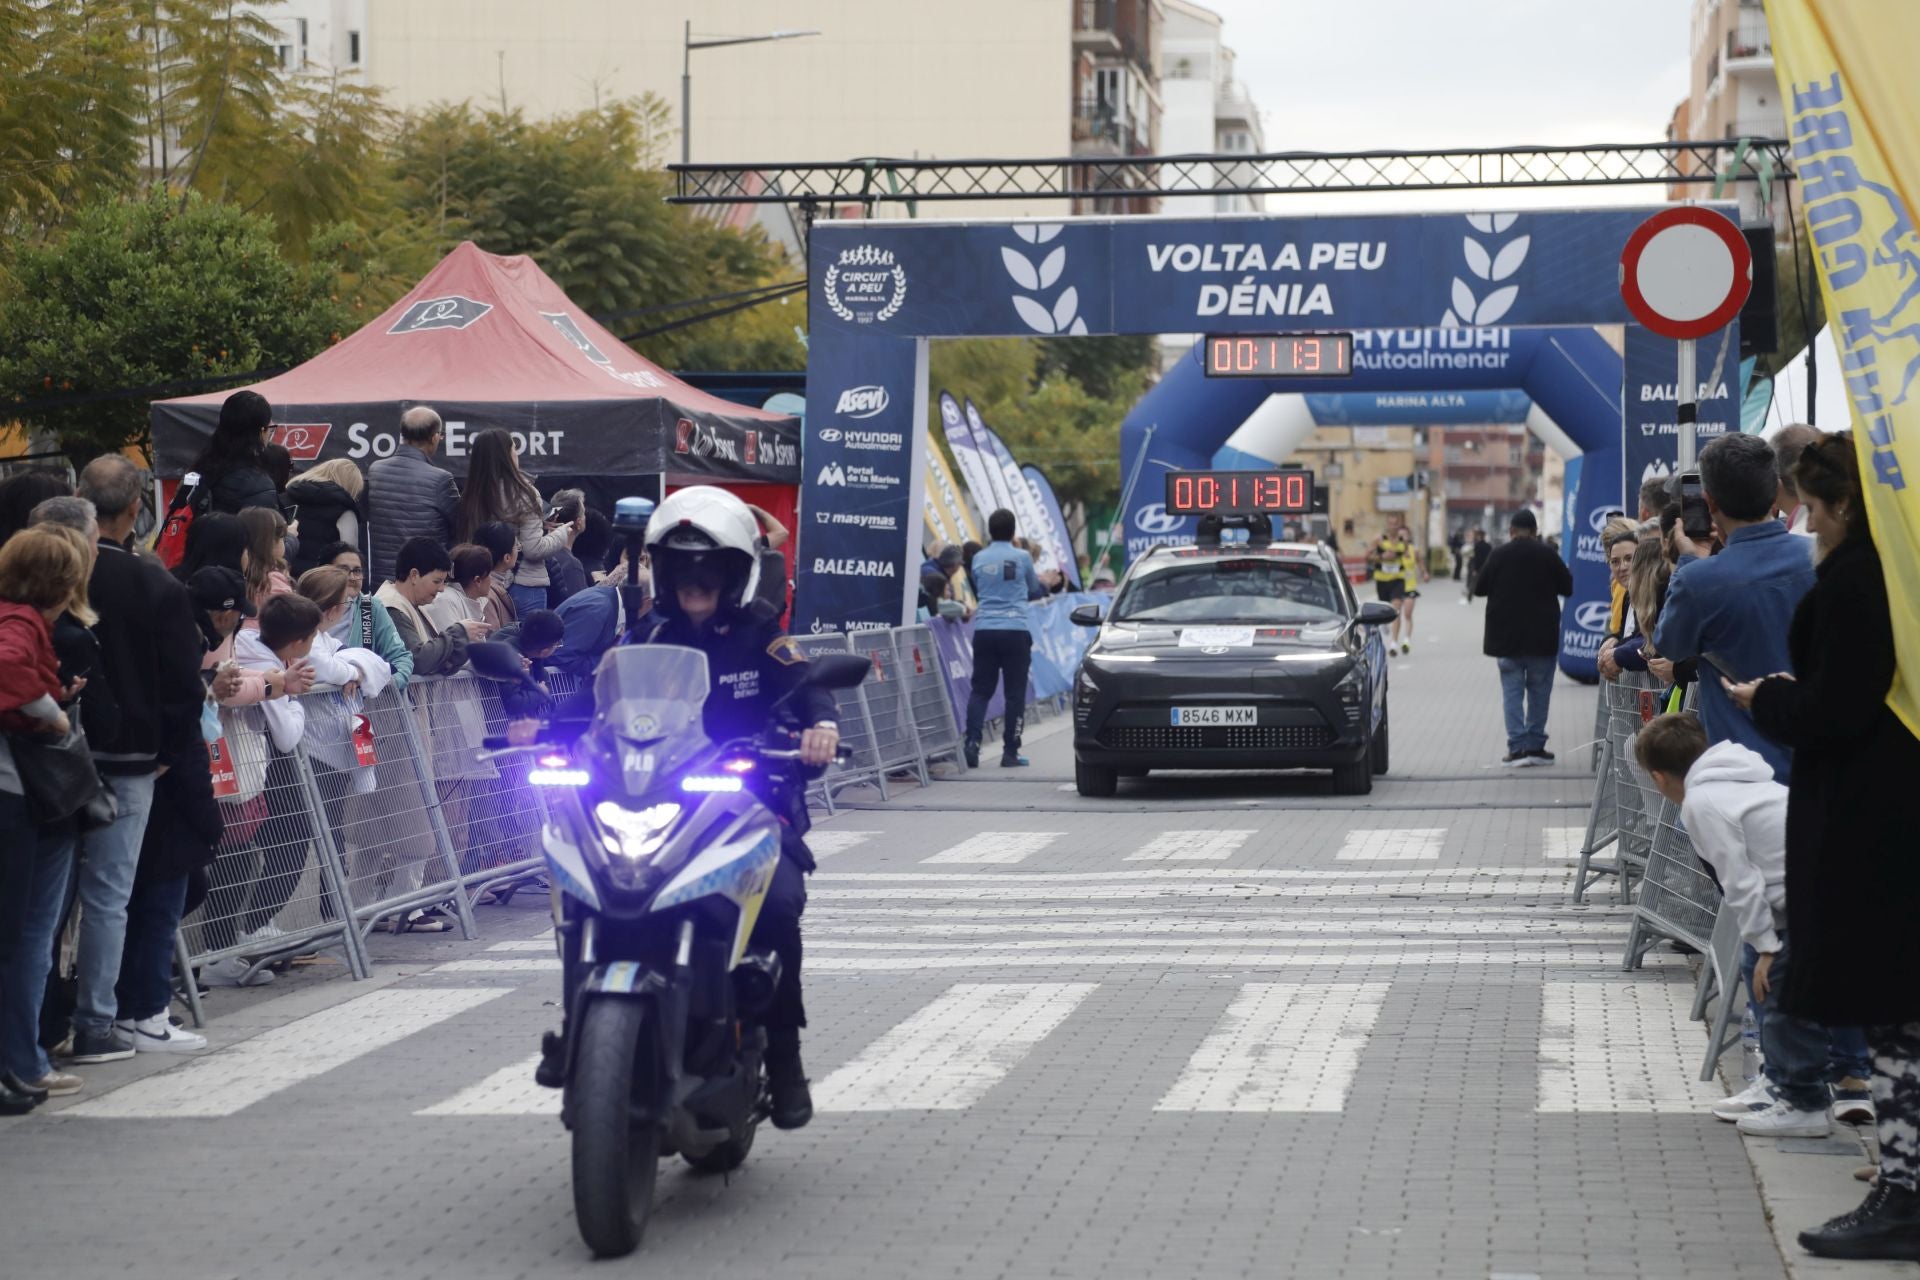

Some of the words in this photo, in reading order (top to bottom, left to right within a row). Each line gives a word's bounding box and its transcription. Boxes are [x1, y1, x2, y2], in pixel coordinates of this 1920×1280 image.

[1147, 244, 1267, 271] VOLTA
[1271, 243, 1302, 270] A
[1309, 242, 1387, 270] PEU
[841, 272, 889, 282] CIRCUIT
[846, 283, 856, 292] A
[859, 283, 883, 293] PEU
[1196, 276, 1334, 315] DÉNIA
[1352, 329, 1511, 349] HYUNDAI
[1214, 340, 1343, 371] 00:11:31
[1352, 350, 1509, 369] Autoalmenar
[835, 386, 884, 414] Asevi
[1376, 396, 1428, 408] MARINA
[1431, 396, 1465, 407] ALTA
[844, 431, 902, 444] HYUNDAI
[844, 441, 902, 451] Autoalmenar
[847, 465, 874, 474] Portal
[847, 474, 858, 482] de
[860, 474, 869, 482] la
[870, 475, 899, 484] Marina
[1175, 477, 1304, 509] 00:11:30
[832, 513, 896, 526] masymas
[813, 558, 895, 577] BALEARIA
[1182, 709, 1220, 724] 8546
[1225, 709, 1254, 723] MXM
